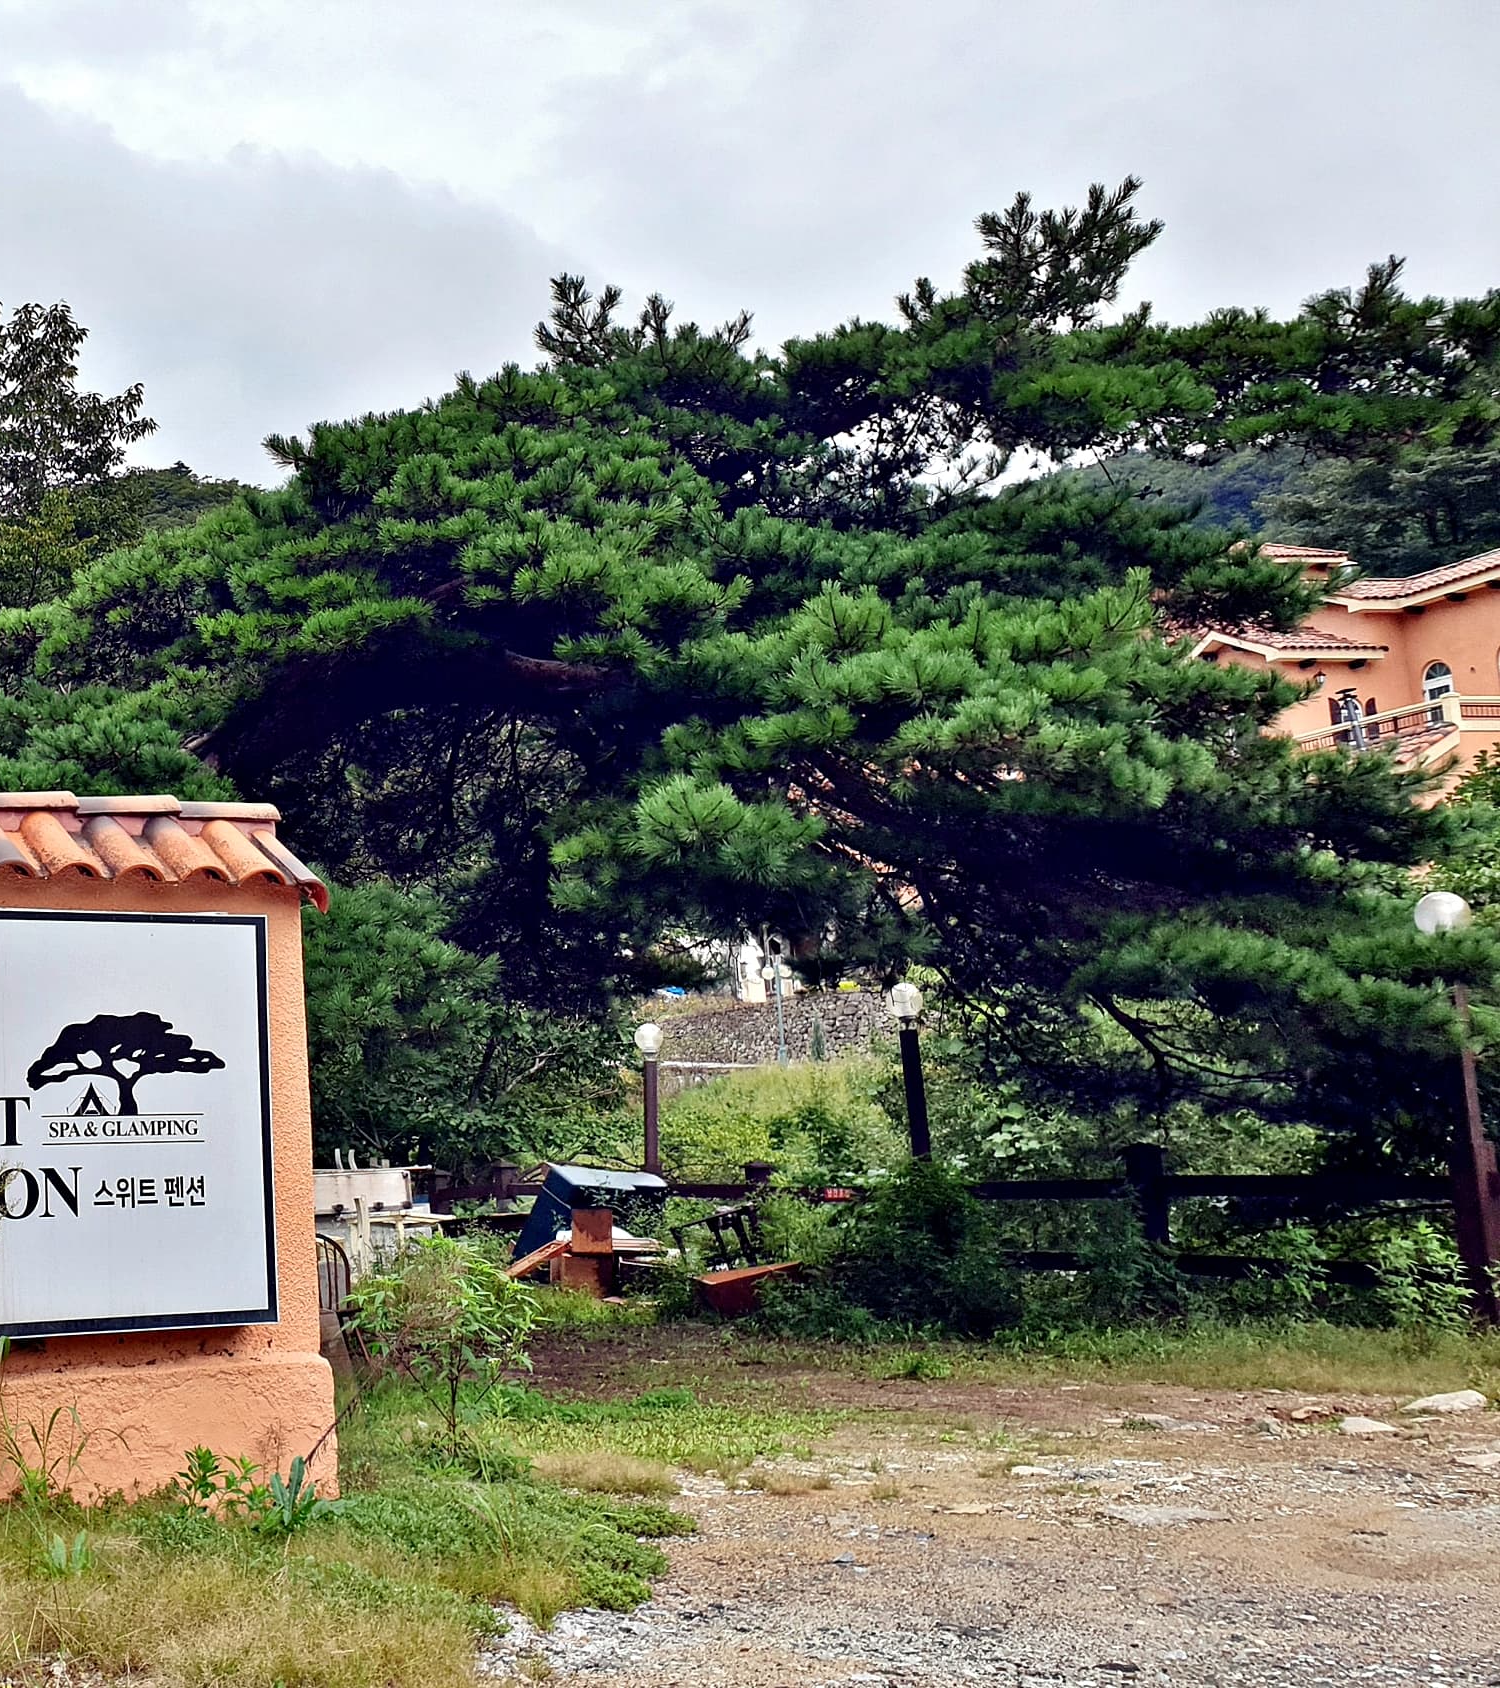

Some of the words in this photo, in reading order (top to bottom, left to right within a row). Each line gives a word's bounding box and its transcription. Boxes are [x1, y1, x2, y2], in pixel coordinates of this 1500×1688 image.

[48, 1121, 81, 1138] SPA
[83, 1120, 98, 1137] &
[102, 1119, 198, 1137] GLAMPING
[93, 1176, 159, 1209] 스위트
[164, 1175, 206, 1207] 펜션
